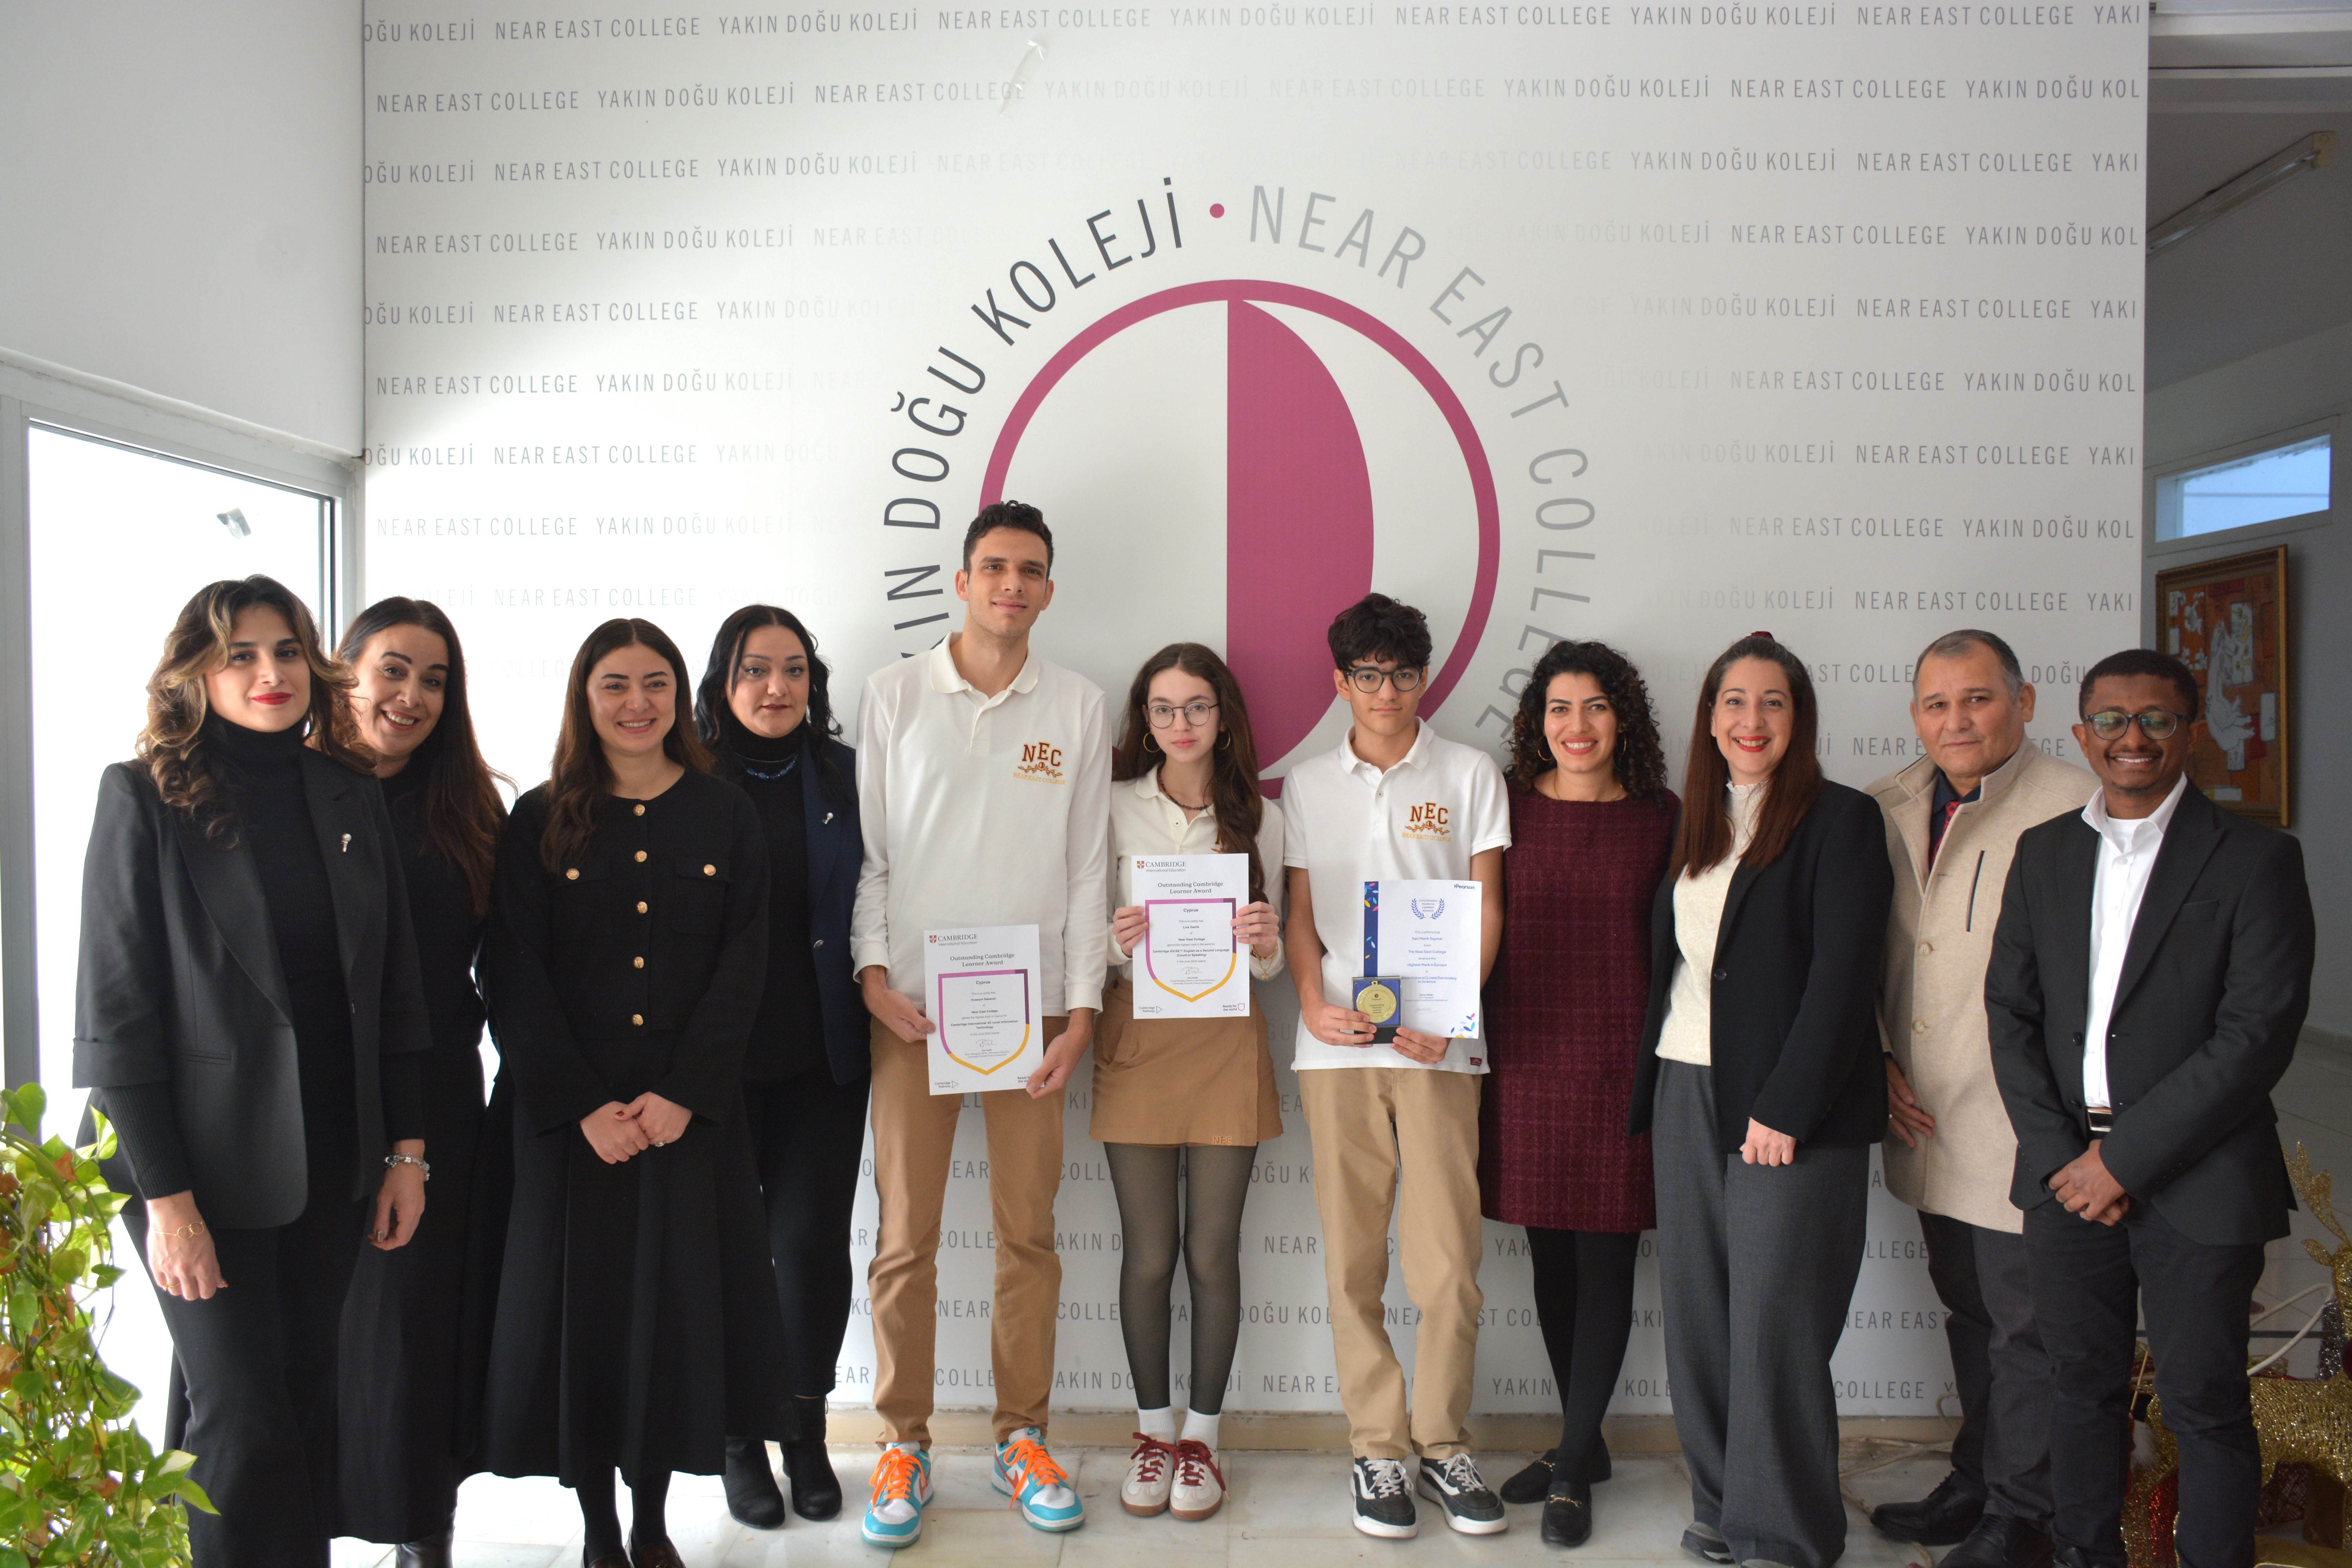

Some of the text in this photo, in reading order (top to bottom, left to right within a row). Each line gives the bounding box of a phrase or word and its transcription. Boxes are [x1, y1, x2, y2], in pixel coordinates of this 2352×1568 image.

[410, 18, 474, 42] KOLEJİ
[496, 21, 546, 40] NEAR
[555, 20, 603, 38] EAST
[611, 17, 700, 37] COLLEGE
[719, 15, 777, 34] YAKIN
[787, 9, 840, 33] DOĞU
[850, 7, 916, 31] KOLEJİ
[939, 11, 991, 29] NEAR
[1000, 9, 1050, 29] EAST
[1058, 8, 1150, 28] COLLEGE
[1170, 8, 1230, 26] YAKIN
[1240, 3, 1295, 26] DOĞU
[1305, 2, 1373, 25] KOLEJİ
[1396, 7, 1449, 25] NEAR
[1459, 6, 1509, 25] EAST
[1517, 6, 1610, 25] COLLEGE
[1631, 7, 1691, 25] YAKIN
[1701, 2, 1756, 25] DOĞU
[1767, 2, 1835, 25] KOLEJİ
[1858, 7, 1911, 25] NEAR
[1921, 6, 1971, 25] EAST
[1980, 6, 2074, 25] COLLEGE
[728, 81, 925, 105] KOLEJİ NEAR EAST
[1702, 147, 1911, 171] DOĞU KOLEJİ NEAR
[377, 232, 578, 254] NEAR EAST COLLEGE
[1966, 222, 2091, 245] YAKIN DOĞU
[971, 176, 1182, 347] KOLEJİ
[1249, 185, 1426, 290] NEAR
[1428, 265, 1570, 419] EAST
[1767, 294, 2071, 318] KOLEJİ NEAR EAST COLLEGE
[490, 368, 716, 394] COLLEGE YAKIN DOĞU
[884, 346, 986, 530] DOĞU
[494, 445, 697, 465] NEAR EAST COLLEGE
[1857, 445, 1909, 463] NEAR
[1918, 445, 1968, 464] EAST
[1977, 445, 2069, 465] COLLEGE
[490, 512, 715, 536] COLLEGE YAKIN DOĞU
[1963, 519, 2023, 537] YAKIN
[2033, 515, 2087, 538] DOĞU
[495, 588, 696, 606] NEAR EAST COLLEGE
[1765, 586, 1967, 610] KOLEJİ NEAR EAST
[1850, 665, 1913, 683] COLLE
[1022, 742, 1062, 767] NEC
[1853, 739, 1906, 756] NEAR
[1410, 802, 1448, 824] NEC
[1213, 1136, 1232, 1145] NEC
[953, 1160, 1290, 1183] EAR OĞU
[1055, 1233, 1928, 1258] AKIN NEAR YAK LLEGE
[939, 1300, 990, 1318] NEAR
[1056, 1302, 1119, 1320] COLLE
[1901, 1311, 1951, 1329] EAST
[935, 1369, 1924, 1399] COLLE AKIN NEAR YAKIN COLLEGE
